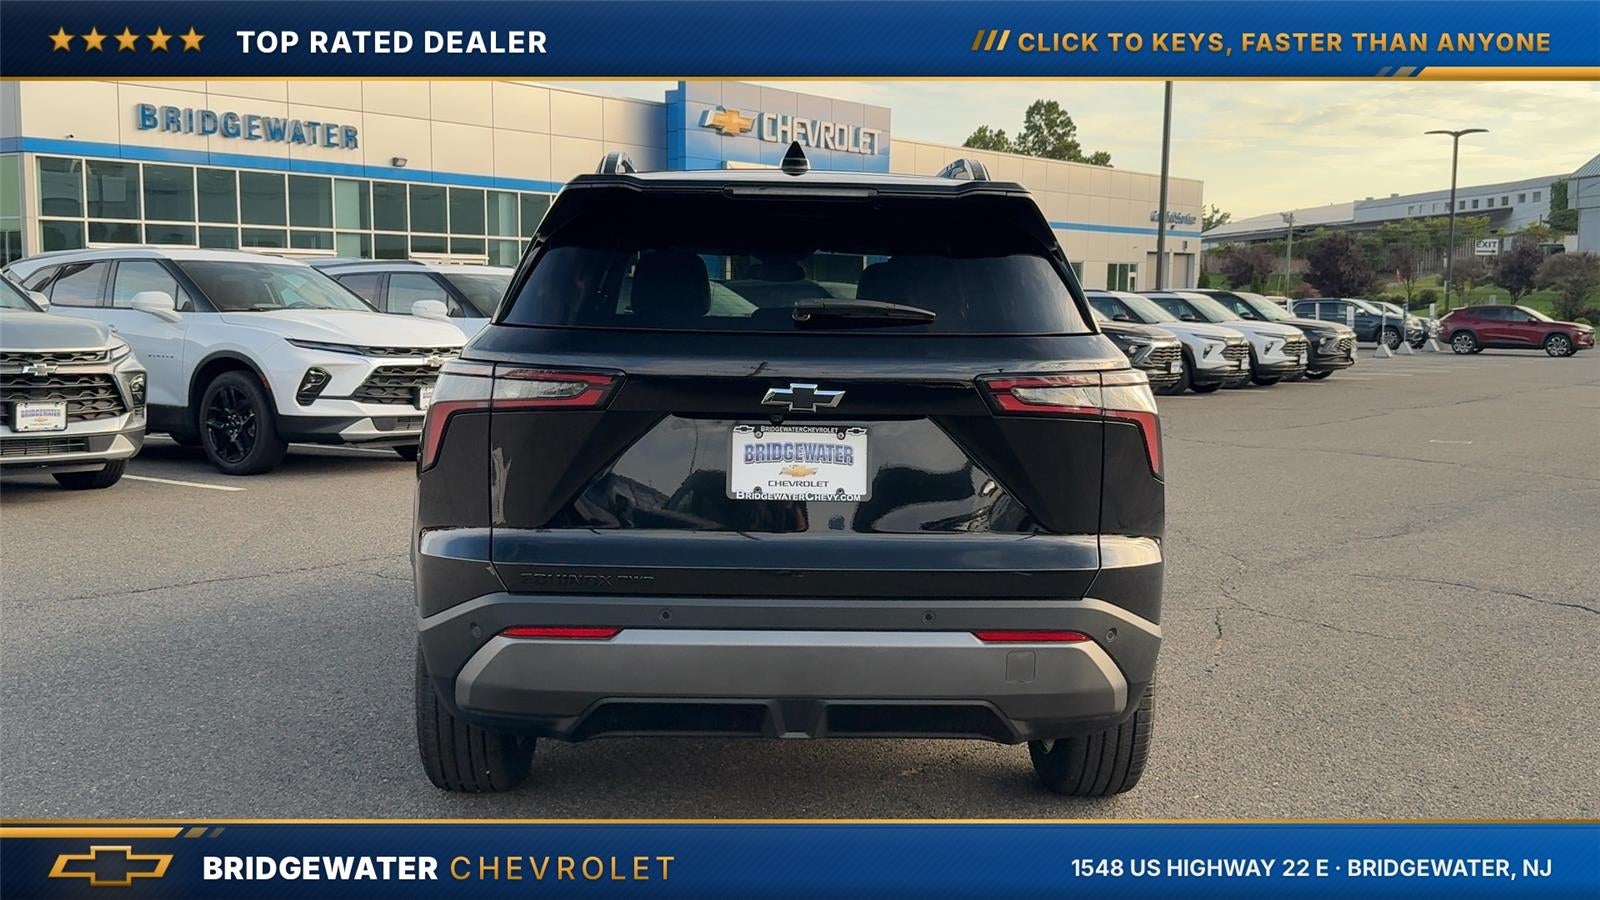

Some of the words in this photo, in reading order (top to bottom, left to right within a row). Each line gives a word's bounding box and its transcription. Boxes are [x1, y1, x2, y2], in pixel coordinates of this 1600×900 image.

[136, 103, 359, 149] BRIDGEWATER
[759, 111, 882, 155] CHEVROLET
[744, 442, 854, 466] BRIDGEWATER
[768, 480, 829, 488] CHEVROLET
